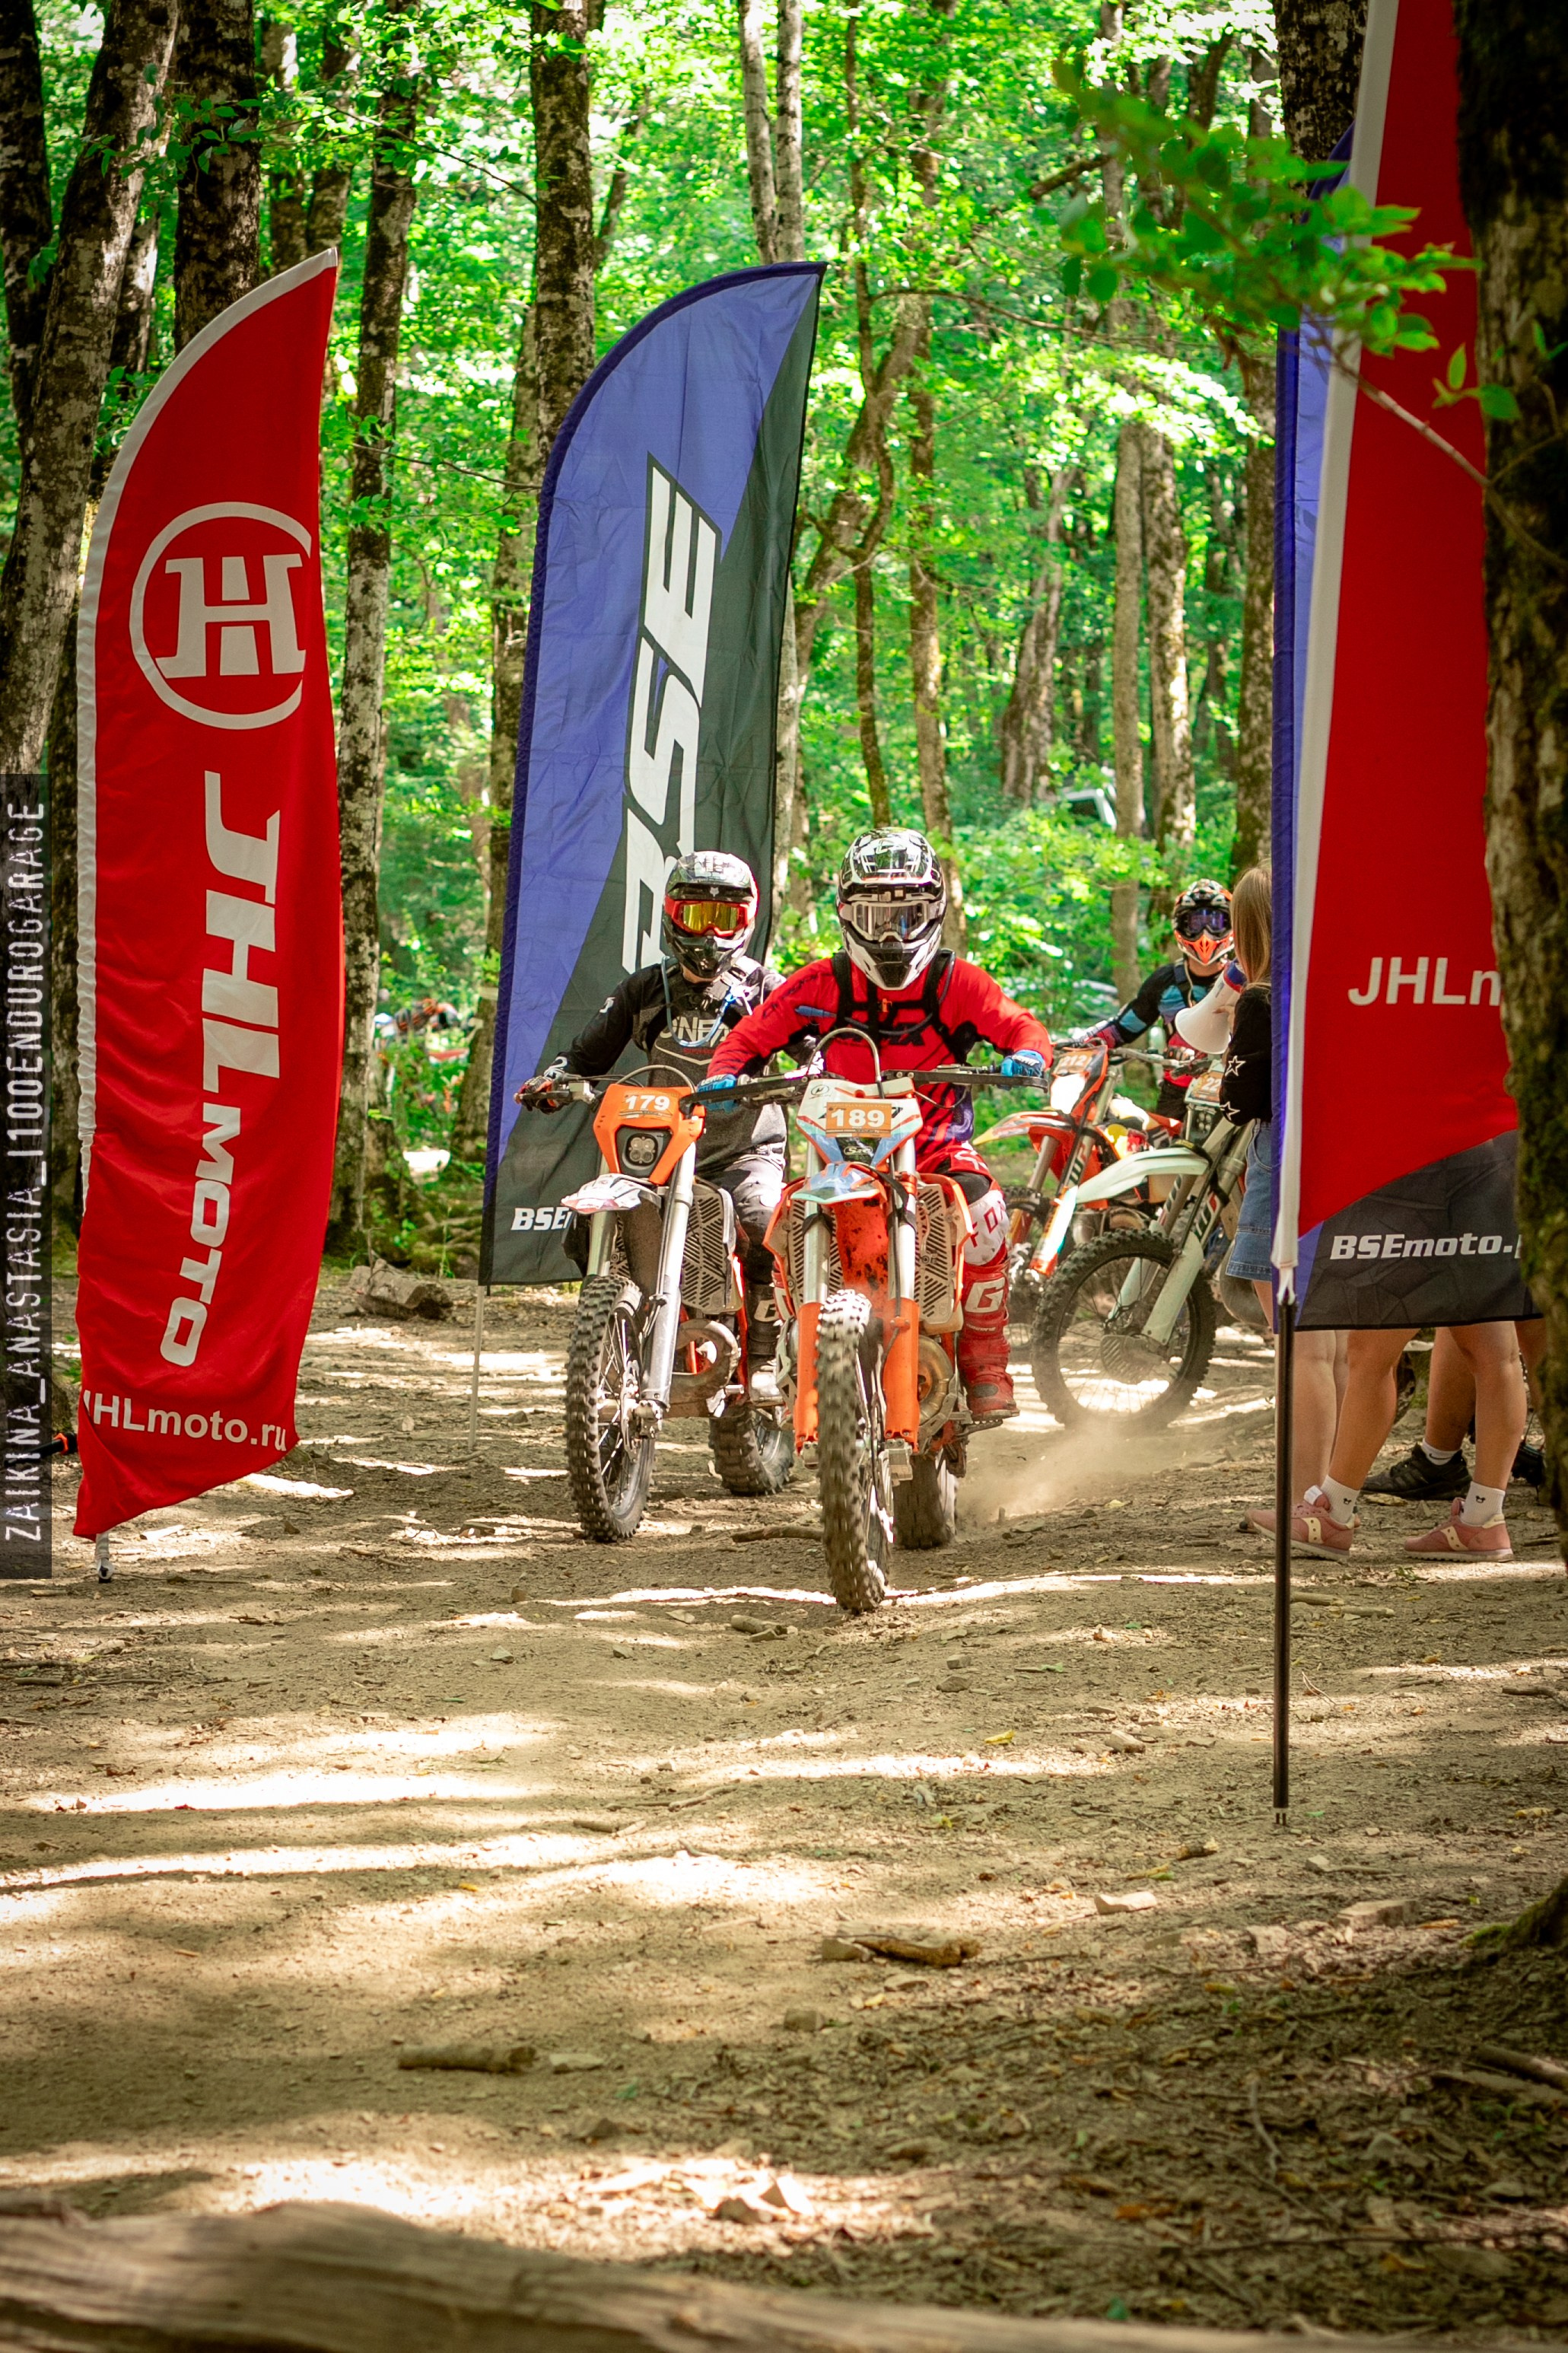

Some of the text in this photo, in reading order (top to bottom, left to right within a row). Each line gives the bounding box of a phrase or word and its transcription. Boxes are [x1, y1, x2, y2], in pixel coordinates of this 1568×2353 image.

[625, 1095, 670, 1111] 179
[831, 1108, 885, 1128] 189
[510, 1206, 572, 1231] BSE
